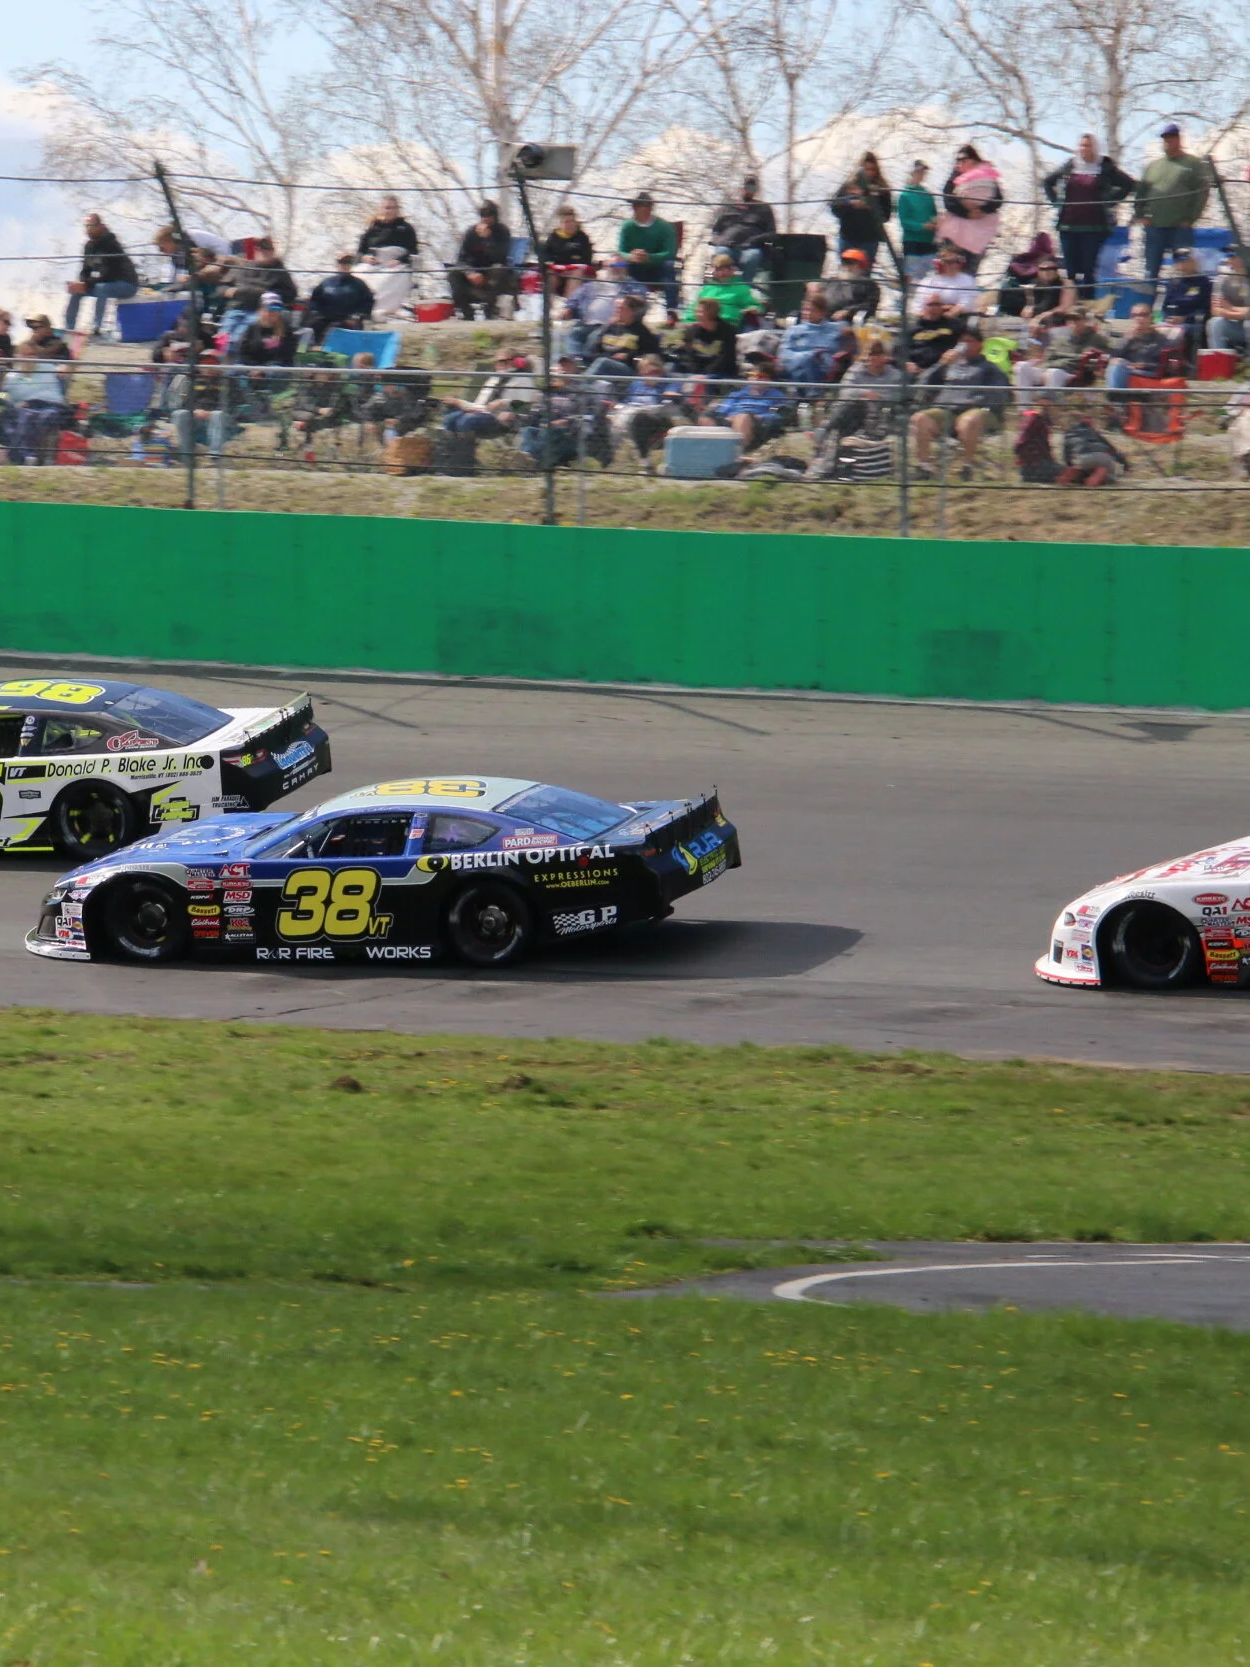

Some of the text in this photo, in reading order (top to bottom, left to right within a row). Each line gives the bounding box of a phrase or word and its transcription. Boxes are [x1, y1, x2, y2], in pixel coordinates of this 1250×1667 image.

[9, 767, 27, 778] VT
[47, 760, 96, 777] Donald
[101, 759, 112, 773] P.
[117, 757, 156, 773] Blake
[162, 755, 177, 769] Jr.
[282, 763, 319, 790] CAMRY
[505, 837, 530, 848] PARD
[450, 850, 519, 870] BERLIN
[219, 863, 250, 877] ACT
[534, 868, 619, 883] EXPRESSIONS
[225, 891, 250, 899] MSD
[277, 868, 390, 937] 38 VT
[191, 906, 217, 914] Bassett
[578, 905, 618, 925] G P
[1202, 906, 1228, 916] QA1
[56, 916, 72, 927] QA1
[295, 947, 335, 959] FIRE
[366, 946, 432, 959] WORKS
